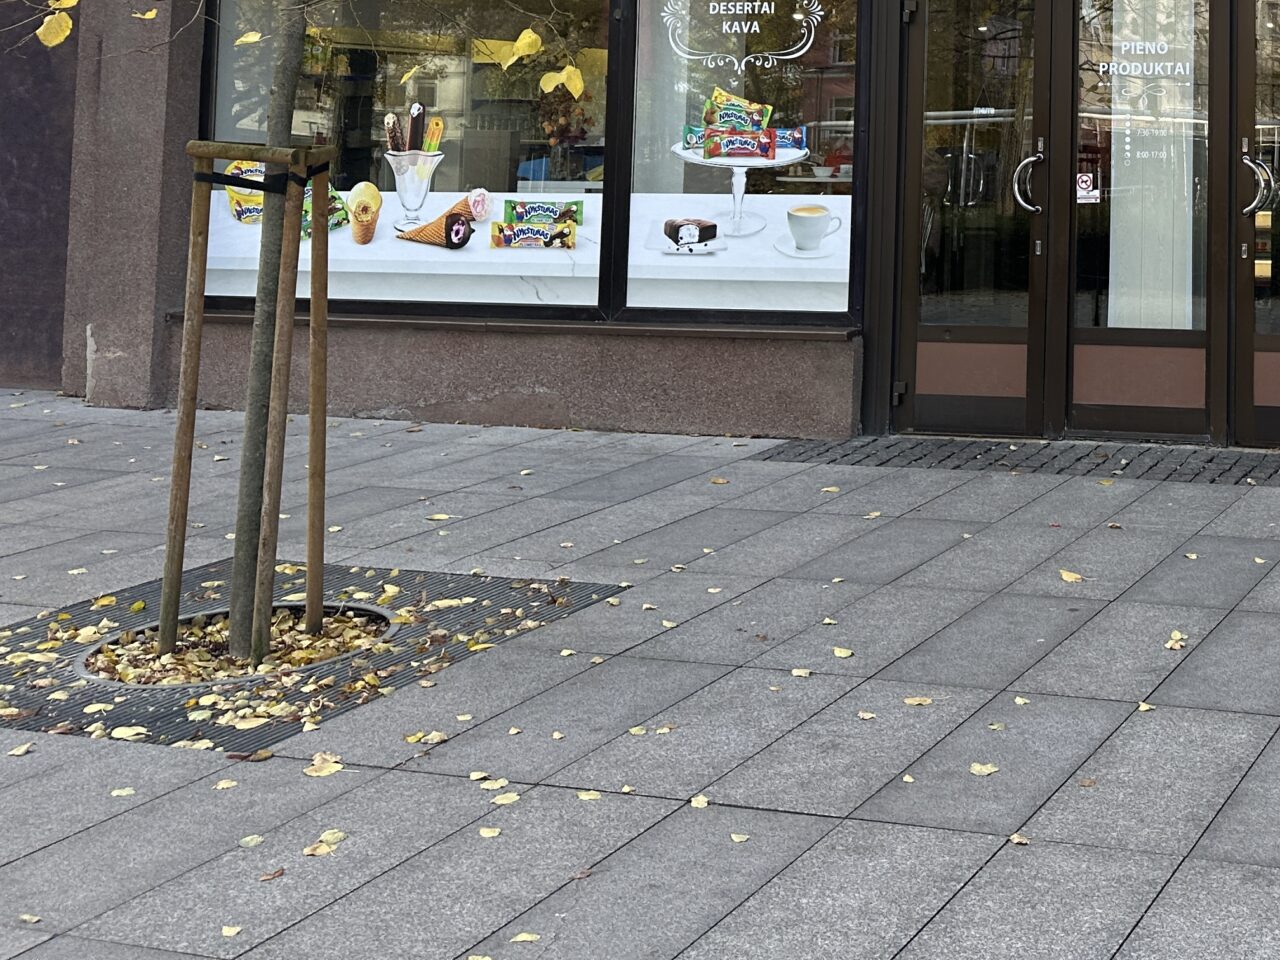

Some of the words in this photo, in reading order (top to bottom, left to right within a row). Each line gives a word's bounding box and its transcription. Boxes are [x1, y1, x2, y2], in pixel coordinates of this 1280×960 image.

[709, 1, 775, 15] DESERTAI
[722, 21, 761, 34] KAVA
[1121, 41, 1169, 55] PIENO
[1099, 62, 1190, 76] PRODUKTAI
[1136, 151, 1167, 159] 8:00-17:00
